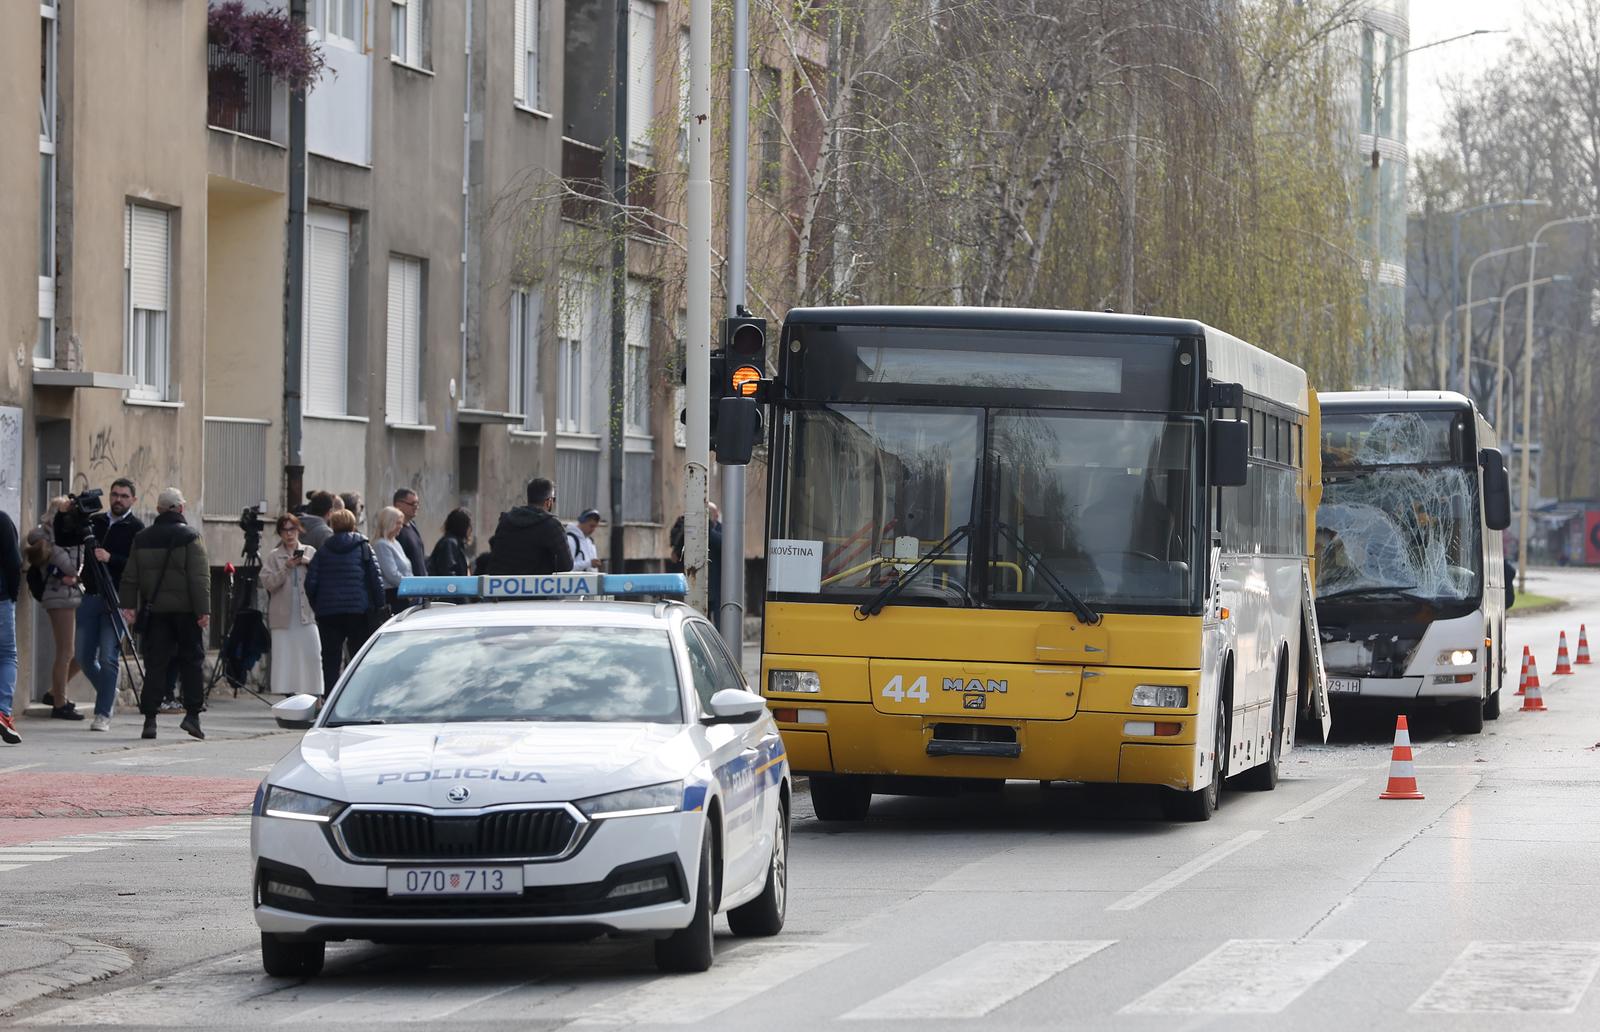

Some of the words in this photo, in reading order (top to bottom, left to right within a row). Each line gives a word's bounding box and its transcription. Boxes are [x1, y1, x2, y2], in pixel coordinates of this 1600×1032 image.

[488, 577, 591, 595] POLICIJA
[881, 674, 930, 704] 44
[942, 677, 1008, 693] MAN
[376, 768, 548, 785] POLICIJA
[406, 870, 446, 892] 070
[464, 869, 504, 891] 713
